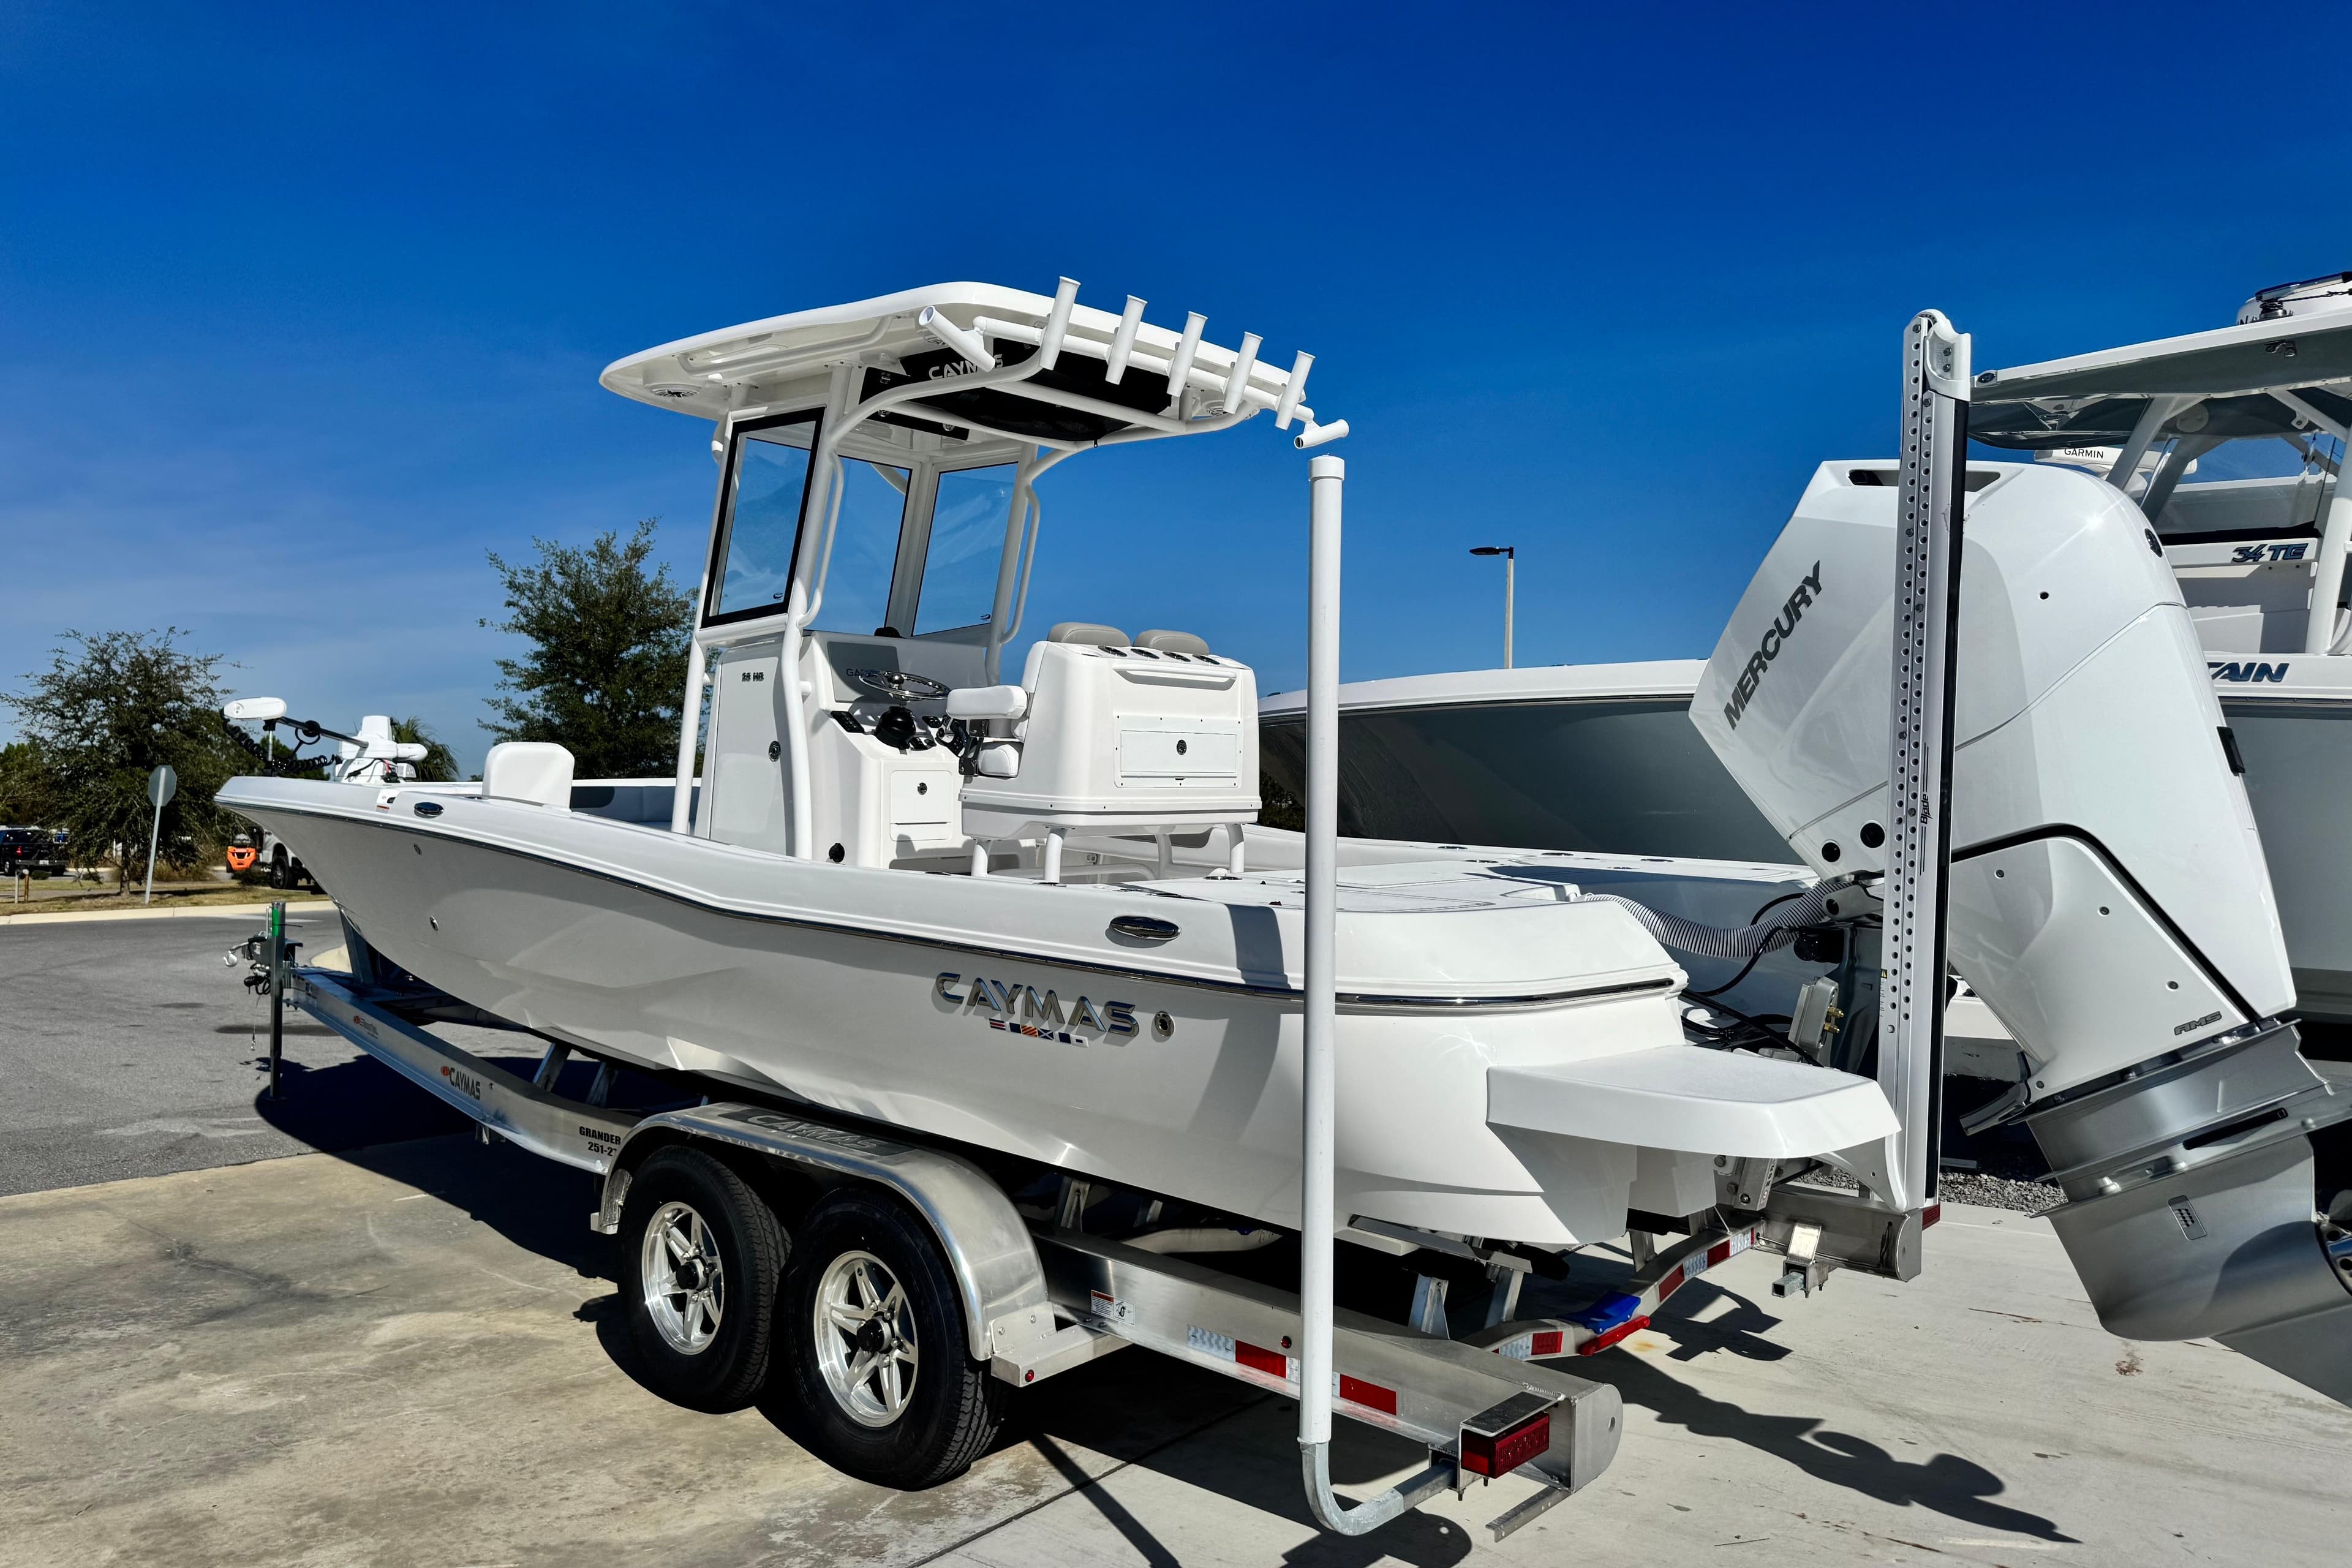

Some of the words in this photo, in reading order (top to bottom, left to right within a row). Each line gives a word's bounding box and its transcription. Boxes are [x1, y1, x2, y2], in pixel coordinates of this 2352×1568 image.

[929, 353, 1003, 380] CAYMS
[2064, 448, 2104, 459] GARMIN
[1724, 559, 1822, 731] MERCURY
[1920, 794, 1933, 824] Blade
[935, 971, 1140, 1038] CAYMAS
[2174, 1011, 2222, 1036] AMS
[450, 1067, 480, 1101] CAYMAS
[579, 1126, 621, 1145] GRANDER
[747, 1115, 877, 1149] CAYMAS
